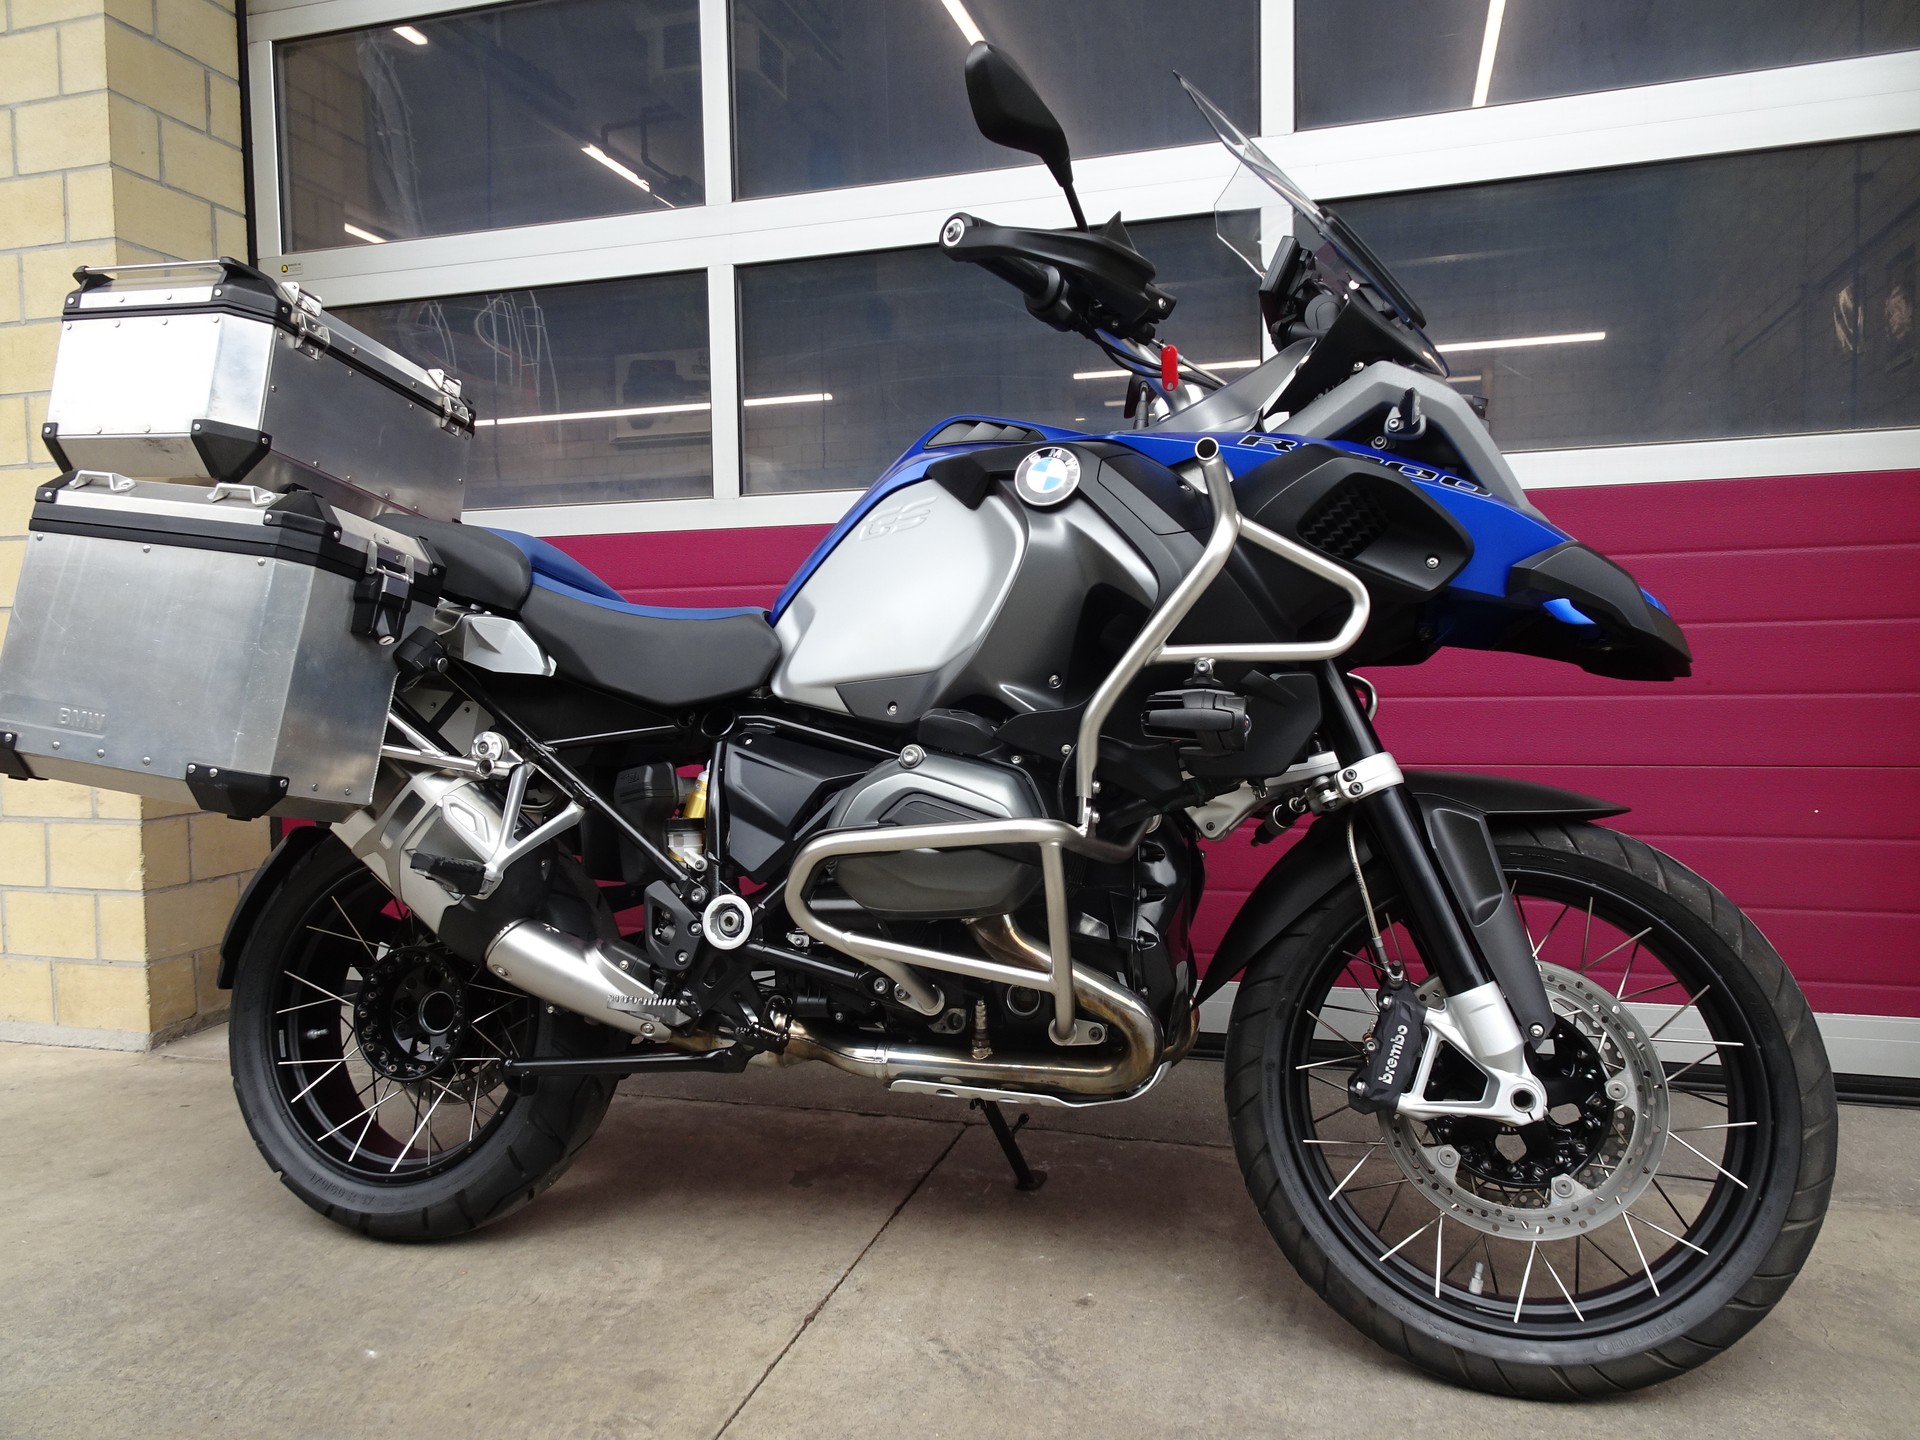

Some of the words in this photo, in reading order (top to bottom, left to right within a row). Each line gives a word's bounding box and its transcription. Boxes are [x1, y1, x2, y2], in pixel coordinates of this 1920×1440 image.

[1028, 448, 1079, 470] BMW
[1236, 434, 1493, 497] R00
[859, 496, 938, 541] GS
[60, 707, 106, 730] BMW
[1378, 1025, 1408, 1085] brembo
